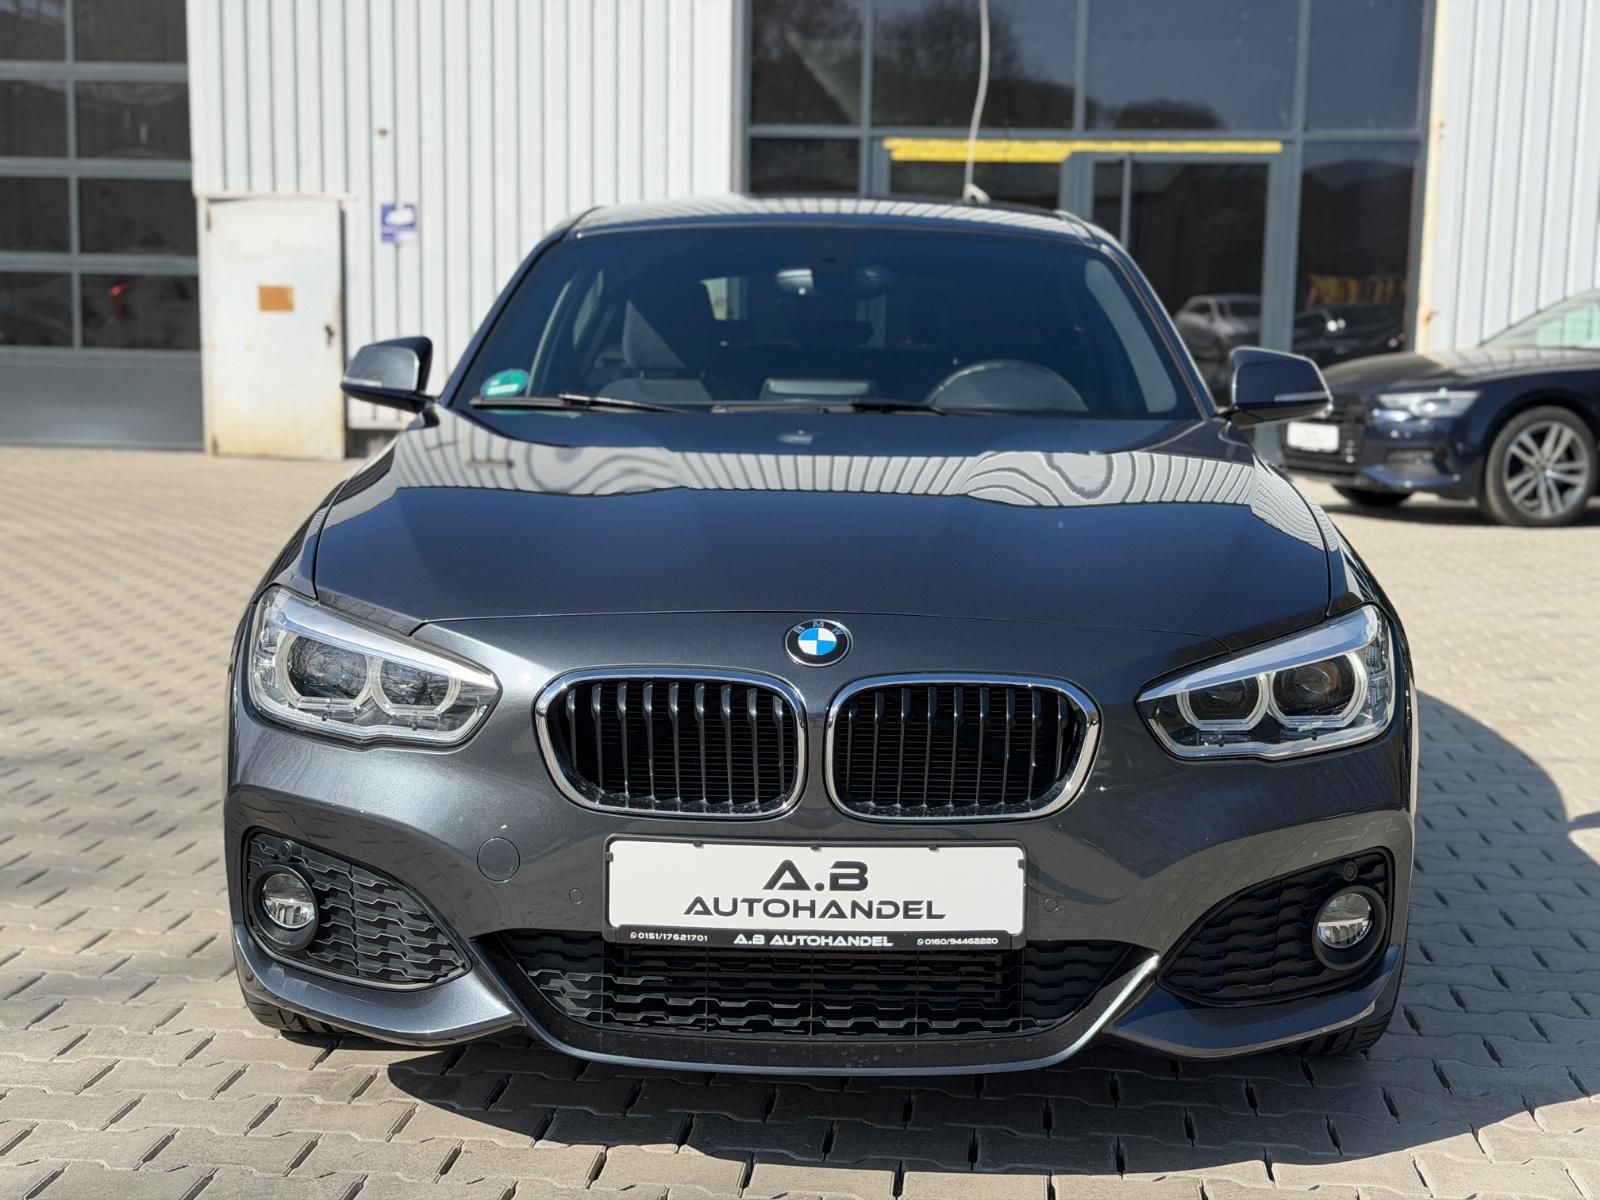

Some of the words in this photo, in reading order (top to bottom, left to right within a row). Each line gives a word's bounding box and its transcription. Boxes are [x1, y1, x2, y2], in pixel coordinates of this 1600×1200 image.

[793, 621, 845, 635] BMW
[762, 859, 869, 892] A.B
[683, 896, 946, 920] AUTOHANDEL
[637, 932, 708, 942] 0151/17621701
[733, 933, 766, 945] A.B
[769, 934, 894, 947] AUTOHANDEL
